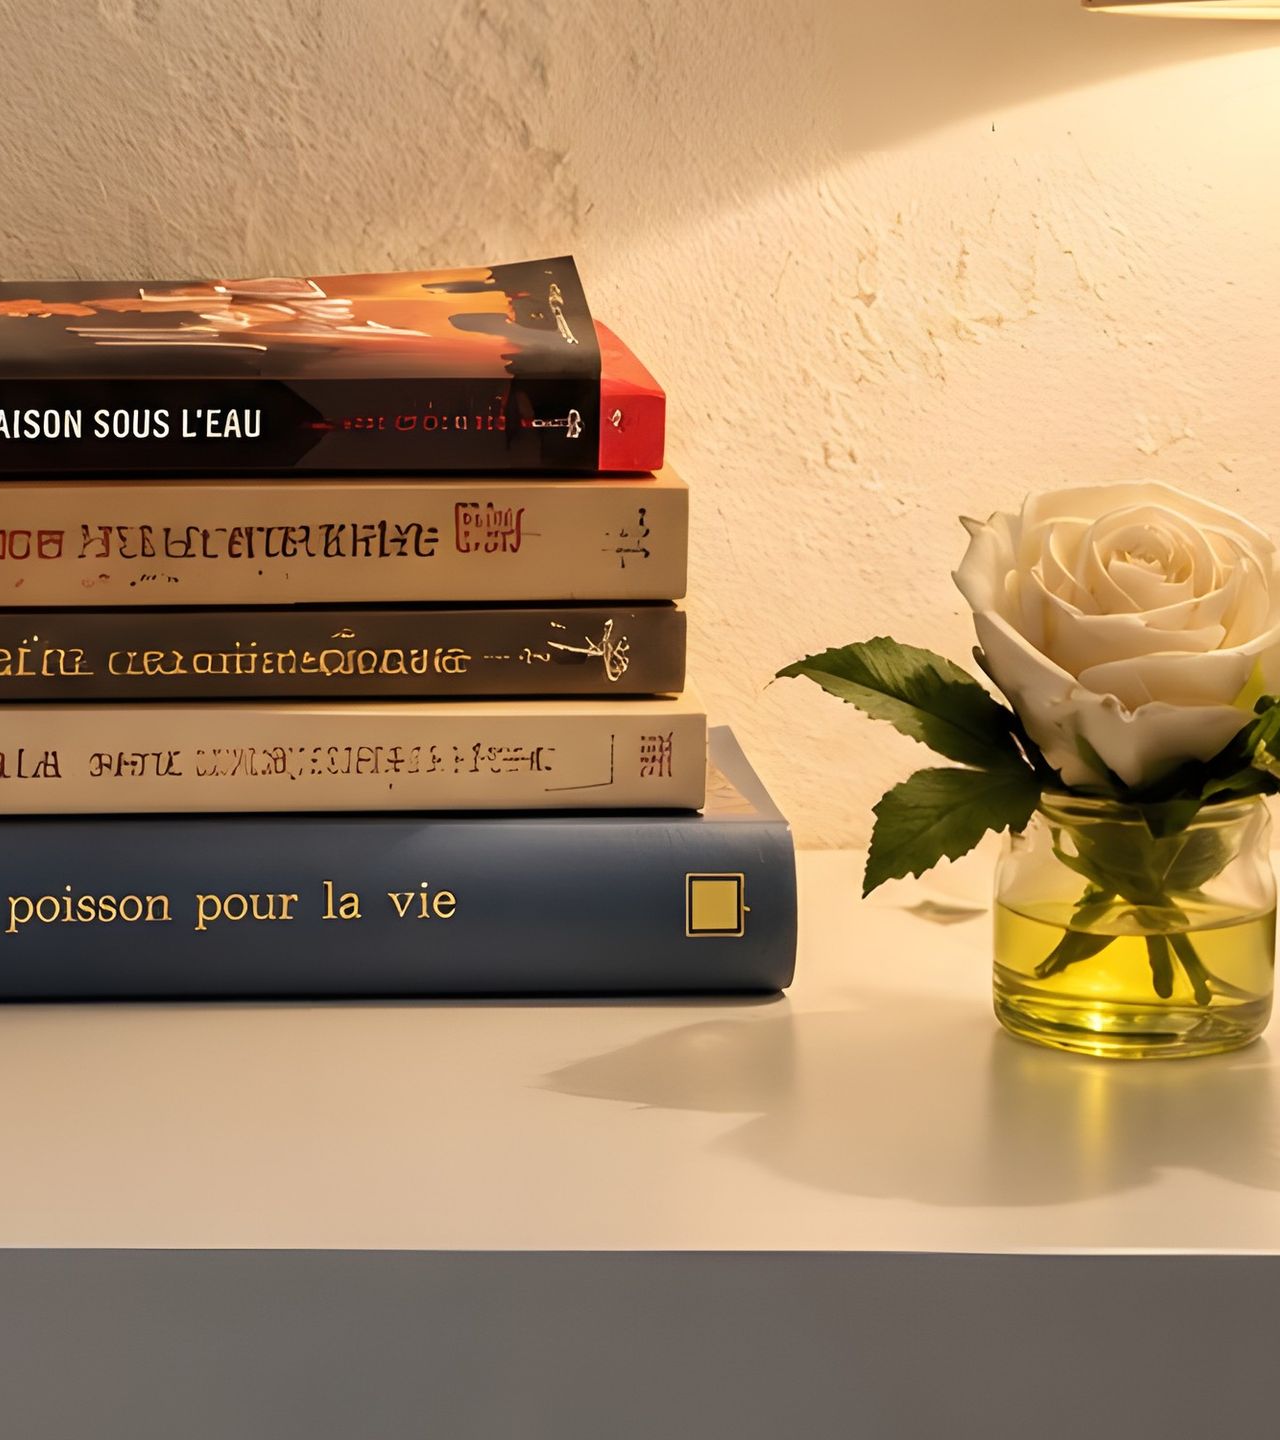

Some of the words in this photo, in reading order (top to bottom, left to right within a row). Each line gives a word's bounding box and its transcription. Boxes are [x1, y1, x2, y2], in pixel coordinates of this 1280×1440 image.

[92, 408, 171, 440] SOUS
[181, 407, 263, 439] L'EAU
[4, 883, 173, 934] poisson
[194, 892, 300, 932] pour
[321, 879, 363, 921] la
[386, 880, 458, 920] vie
